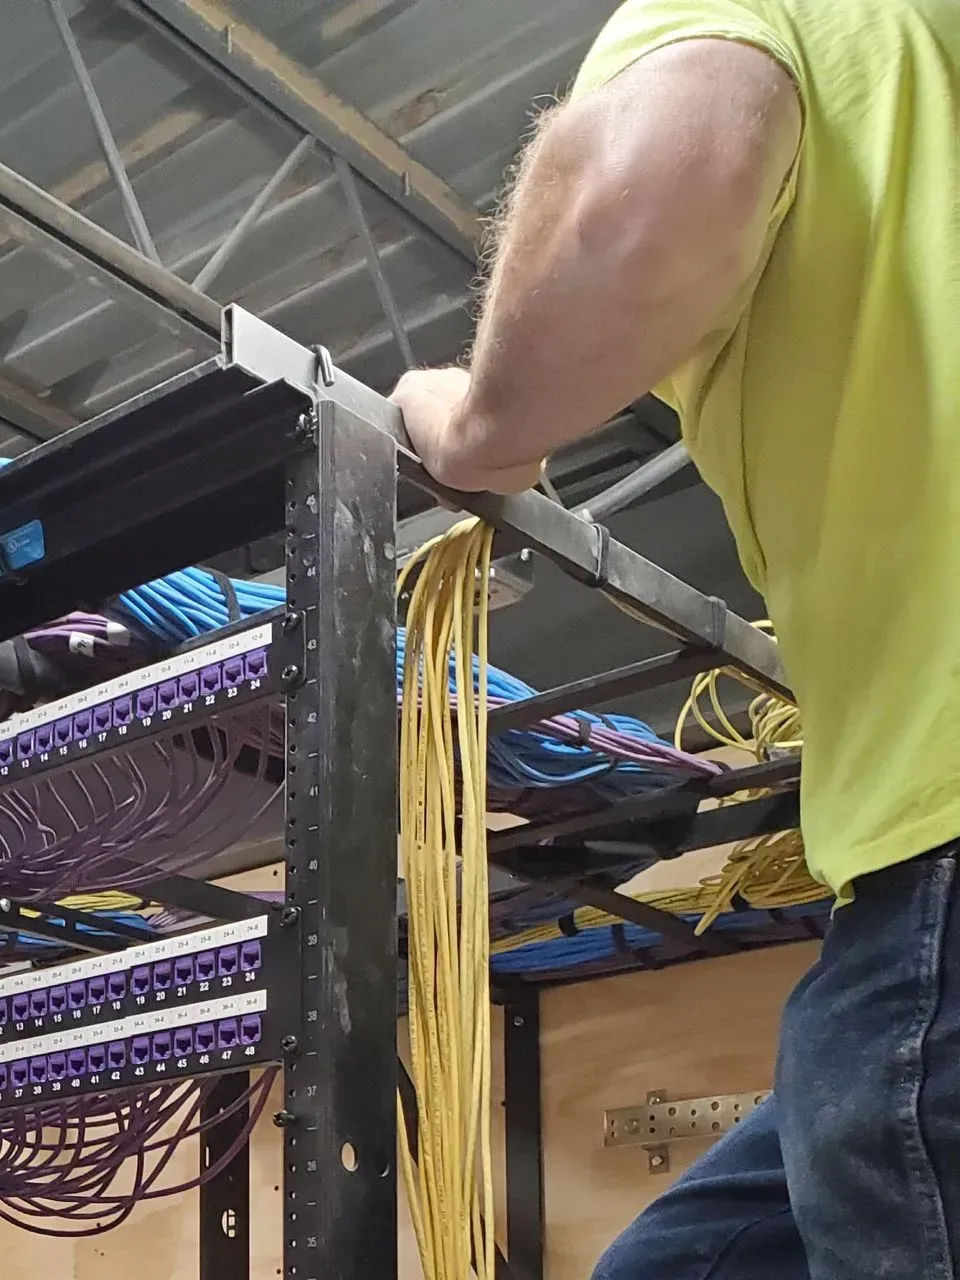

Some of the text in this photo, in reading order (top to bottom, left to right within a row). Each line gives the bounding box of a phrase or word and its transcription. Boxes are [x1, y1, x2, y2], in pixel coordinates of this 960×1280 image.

[306, 565, 317, 578] 44
[306, 638, 318, 651] 43
[306, 711, 318, 724] 42
[0, 766, 9, 776] 12
[21, 758, 30, 769] 13
[40, 752, 49, 763] 14
[59, 745, 68, 756] 15
[78, 738, 88, 749] 16
[97, 731, 107, 743] 17
[118, 725, 127, 735] 18
[142, 716, 152, 727] 19
[162, 709, 172, 721] 20
[183, 702, 193, 714] 21
[205, 694, 216, 706] 22
[227, 686, 238, 698] 23
[250, 678, 261, 690] 24
[308, 785, 319, 797] 41
[307, 858, 319, 872] 40
[306, 933, 318, 946] 39
[15, 971, 256, 1031] 13 14 15 16 17 18 19 20 21 22 23 24
[306, 1009, 318, 1022] 38
[14, 1088, 24, 1098] 37
[32, 1085, 42, 1095] 38
[52, 1081, 61, 1092] 39
[71, 1078, 81, 1088] 40
[90, 1075, 100, 1084] 41
[110, 1071, 121, 1081] 42
[134, 1066, 145, 1076] 43
[155, 1062, 166, 1073] 44
[177, 1058, 188, 1068] 45
[199, 1054, 210, 1064] 46
[221, 1050, 232, 1060] 47
[244, 1045, 255, 1056] 48
[306, 1084, 318, 1097] 37
